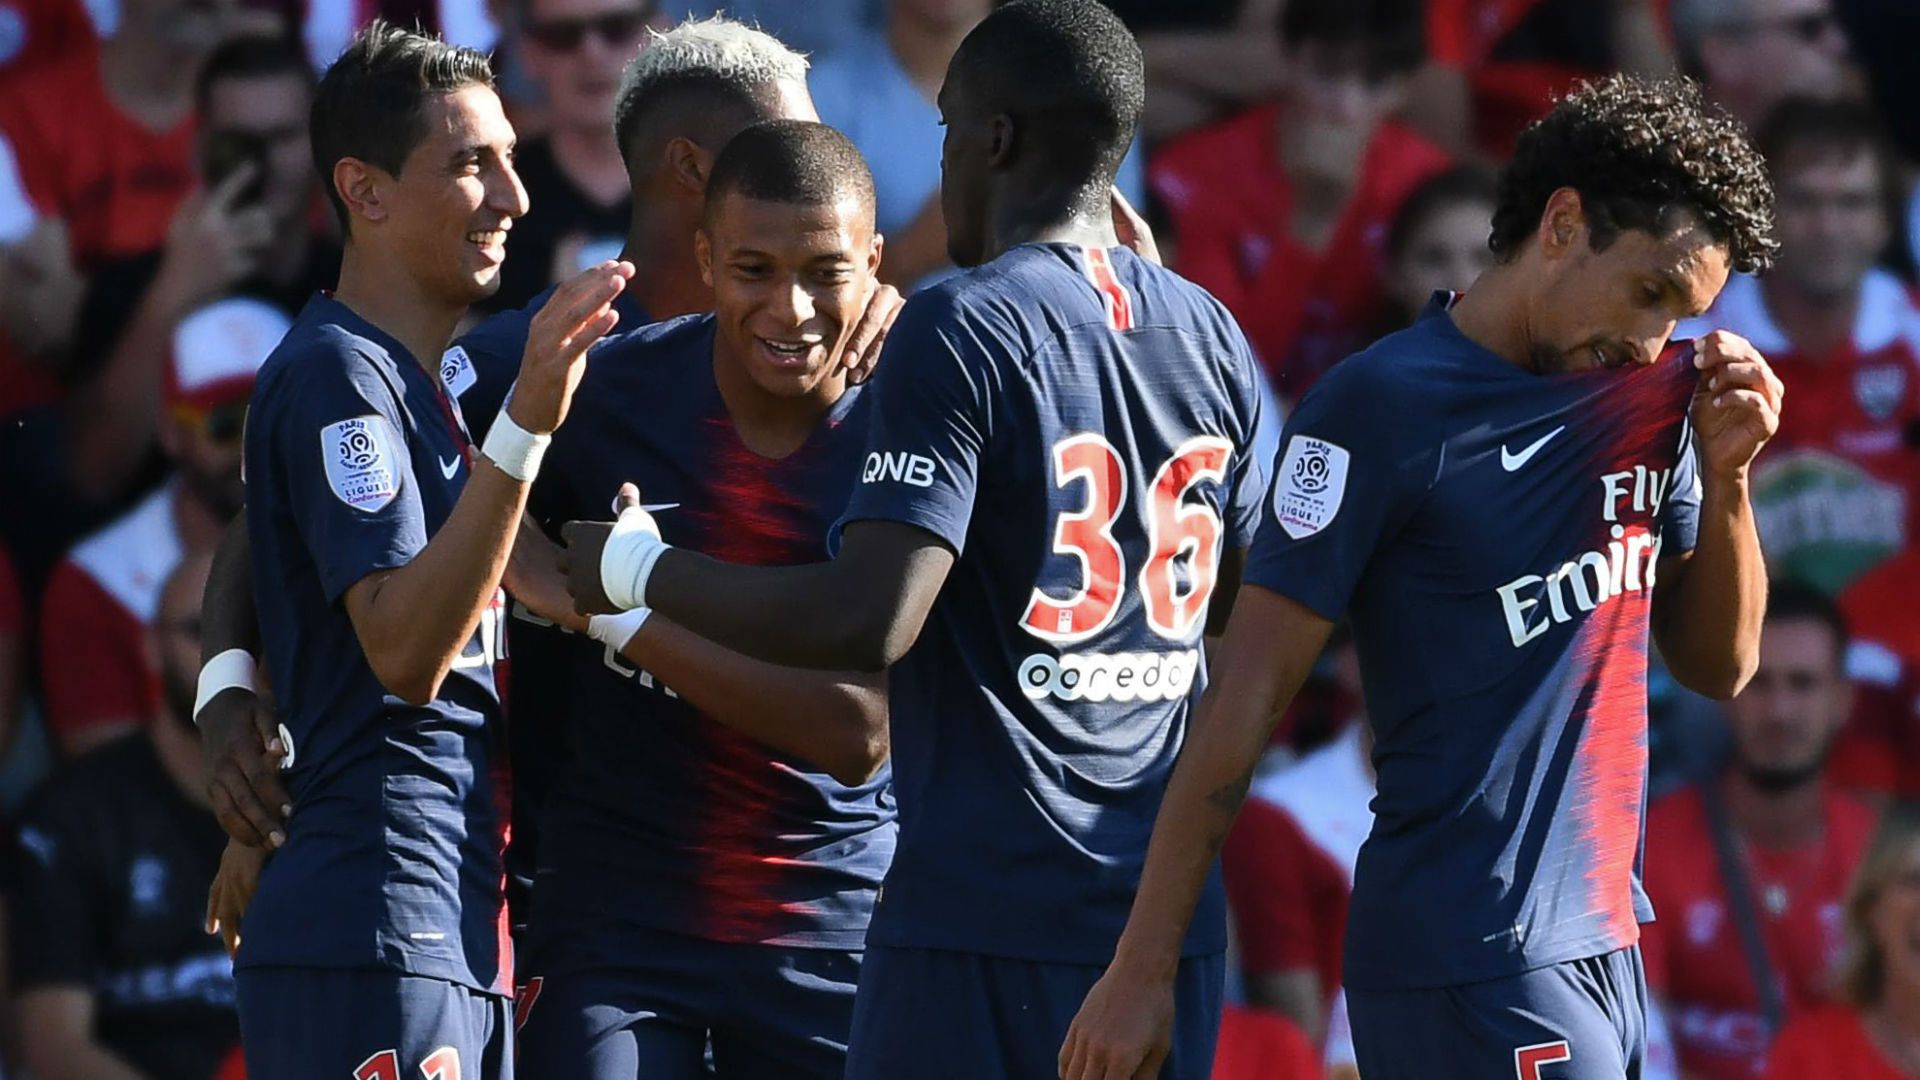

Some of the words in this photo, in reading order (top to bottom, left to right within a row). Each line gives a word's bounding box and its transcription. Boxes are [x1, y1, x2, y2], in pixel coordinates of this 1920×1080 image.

[339, 420, 365, 432] PARIS
[1306, 441, 1331, 456] PARIS
[862, 451, 936, 487] QNB
[1600, 465, 1670, 517] Fly
[1281, 505, 1312, 521] LIGUE
[1018, 433, 1235, 642] 36
